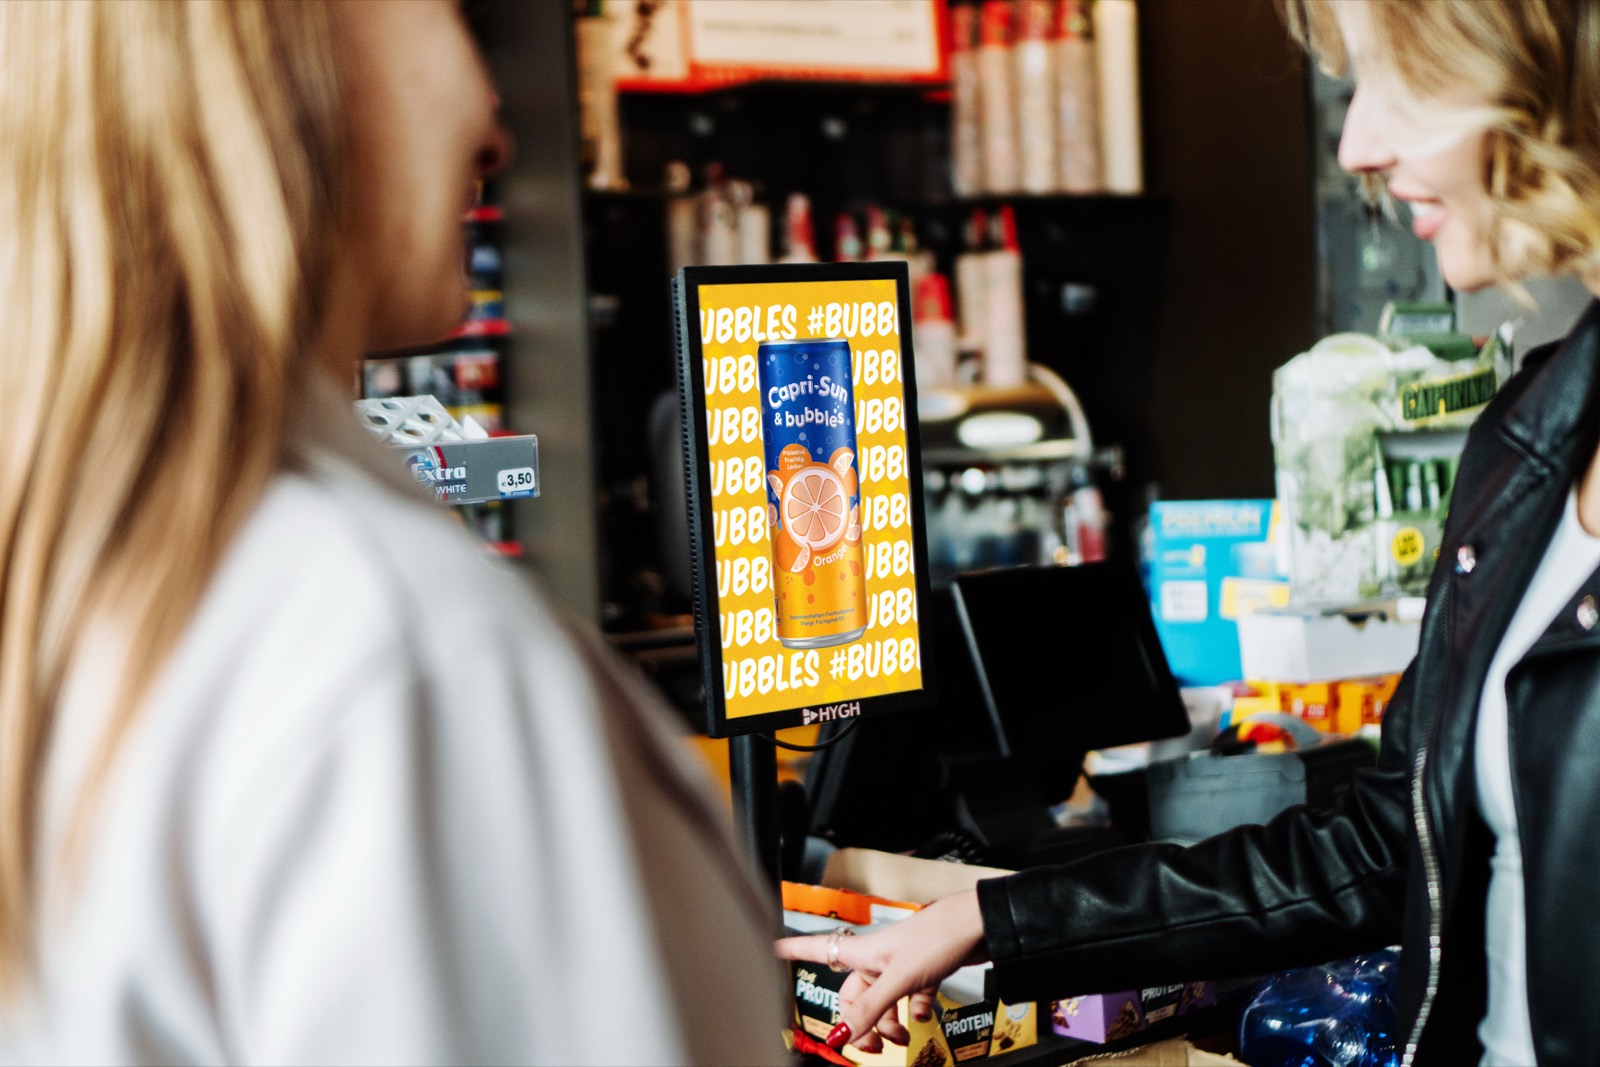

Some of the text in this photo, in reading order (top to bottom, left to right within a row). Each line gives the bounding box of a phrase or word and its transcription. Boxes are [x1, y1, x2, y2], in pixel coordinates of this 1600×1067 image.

[768, 374, 849, 409] Capri-Sun
[774, 406, 844, 428] & bubbles
[411, 462, 466, 482] Extra
[436, 484, 467, 495] WHITE
[813, 544, 848, 567] Orange
[819, 702, 861, 722] HYGH
[946, 1011, 993, 1037] PROTEIN
